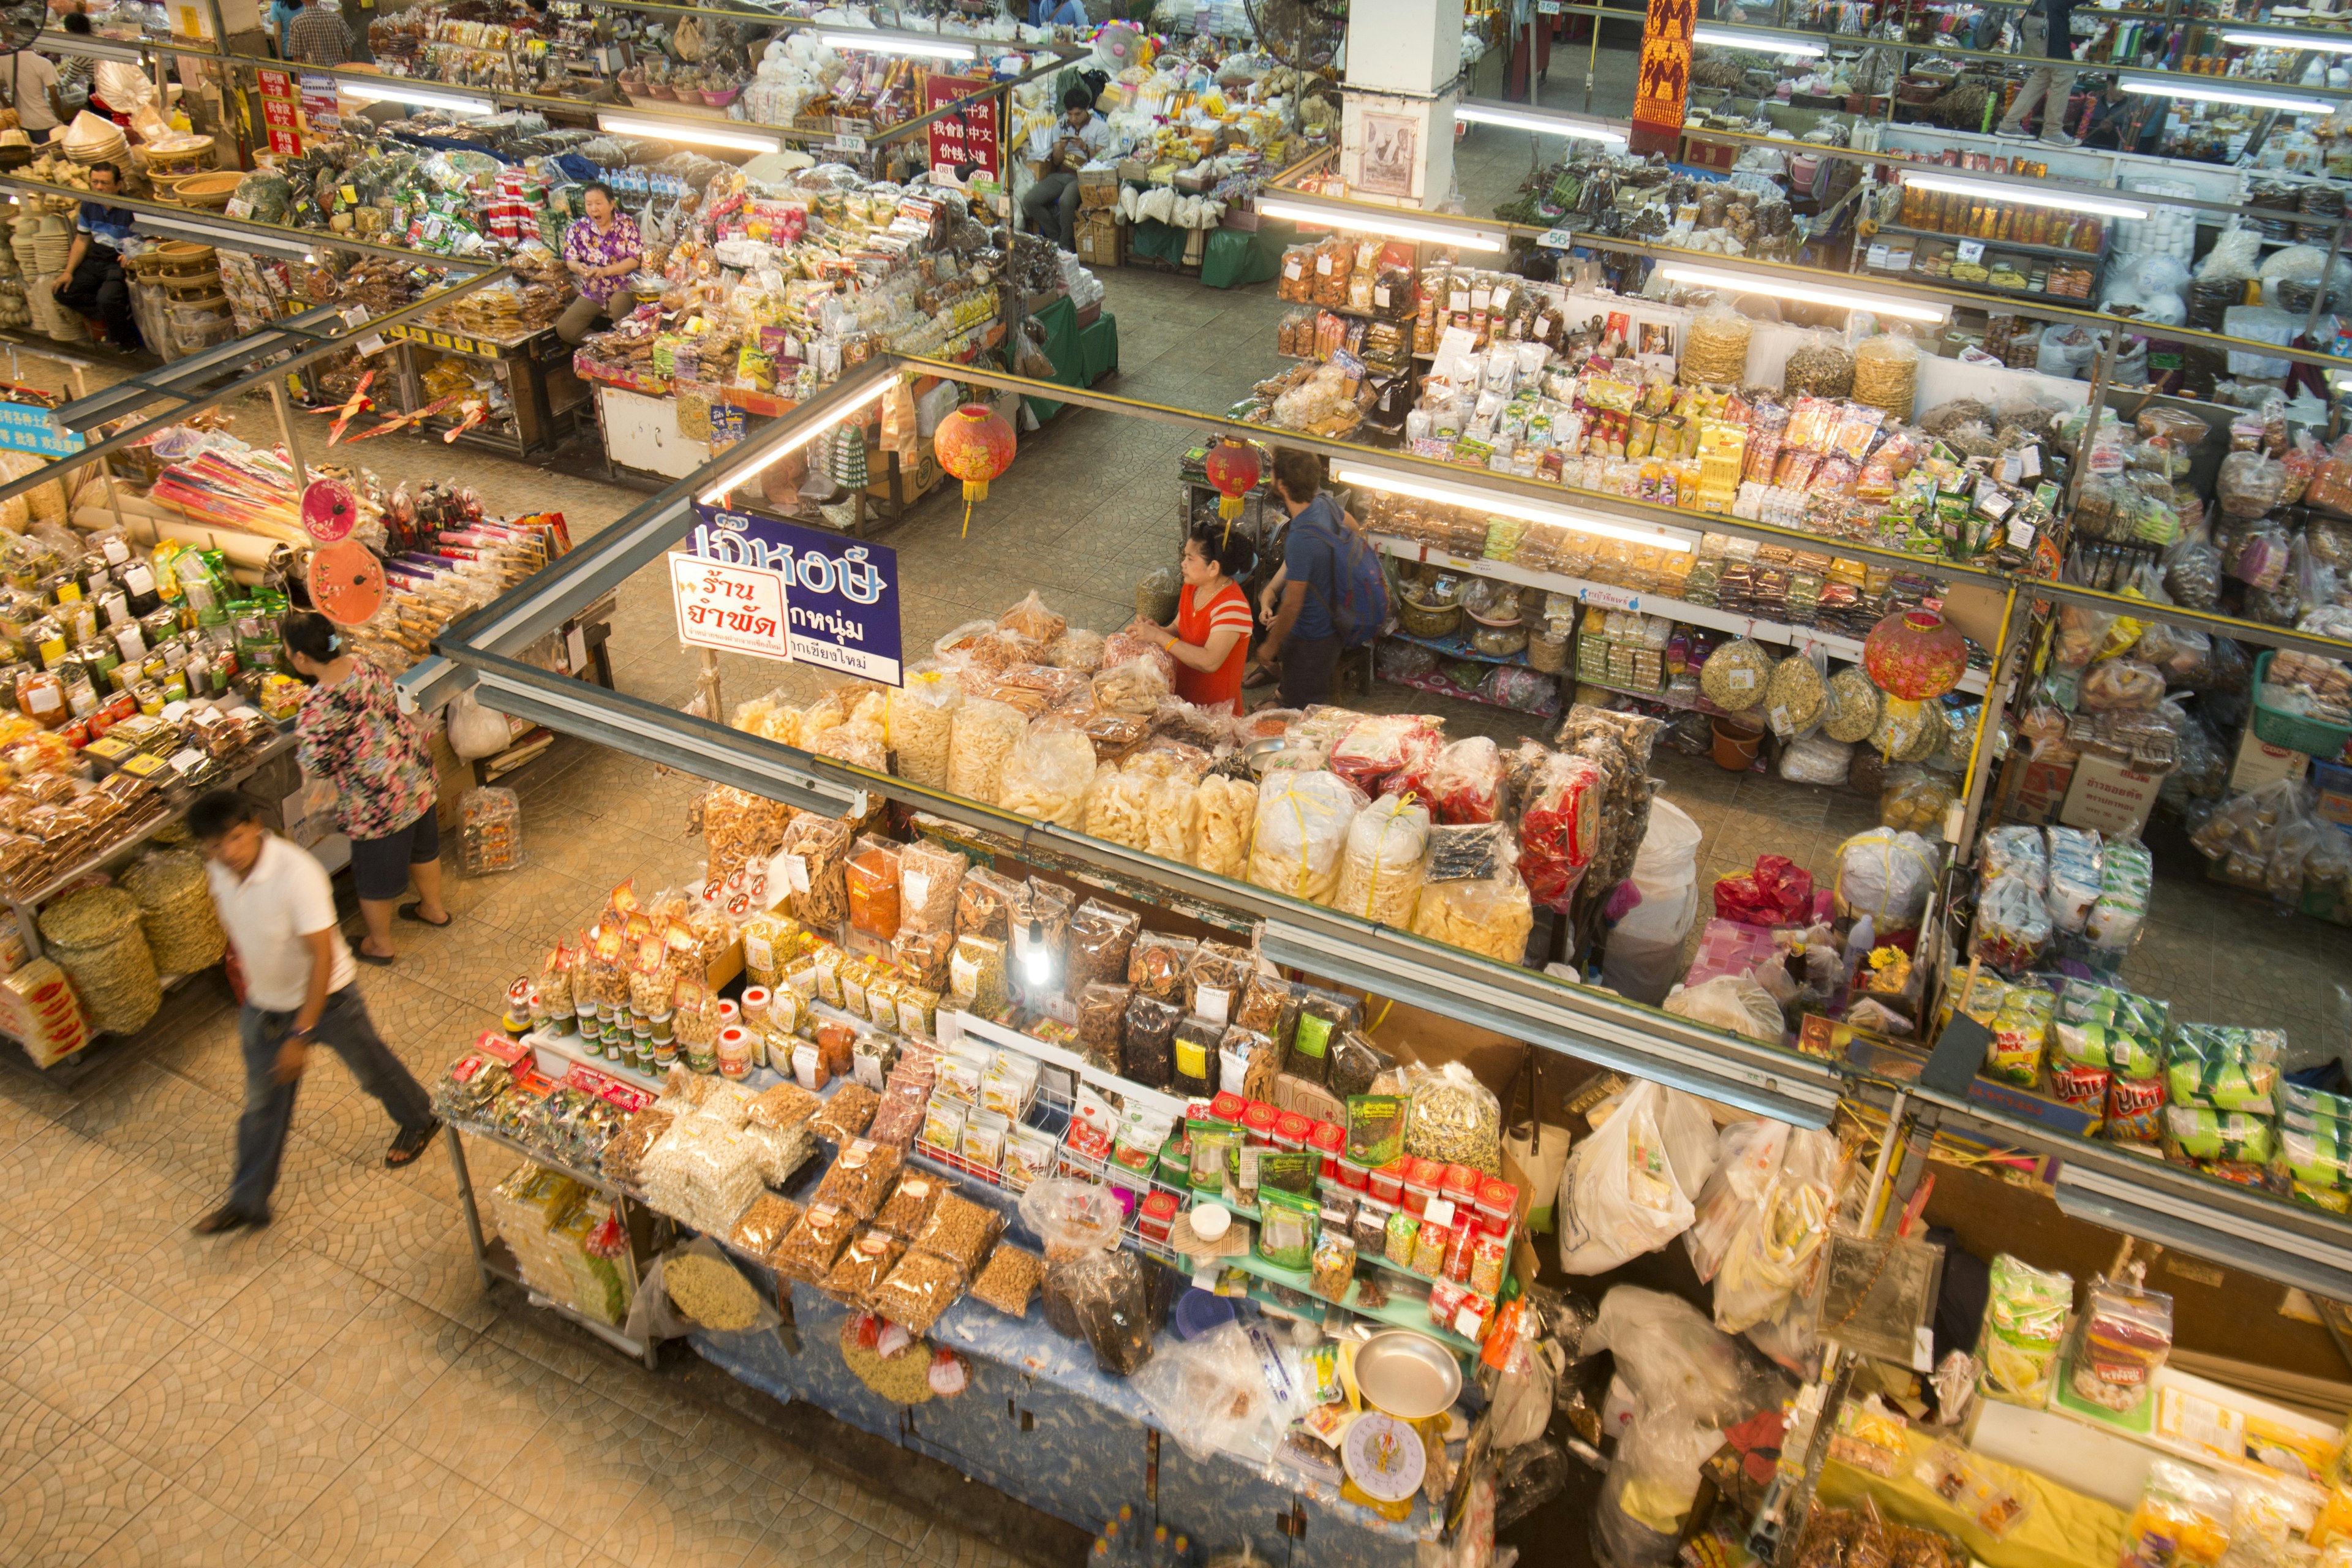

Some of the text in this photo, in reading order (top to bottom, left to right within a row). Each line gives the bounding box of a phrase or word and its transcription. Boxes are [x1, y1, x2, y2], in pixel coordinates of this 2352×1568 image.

[1549, 232, 1567, 245] 56
[703, 569, 755, 600] ร้าน
[2263, 745, 2288, 756] COOK
